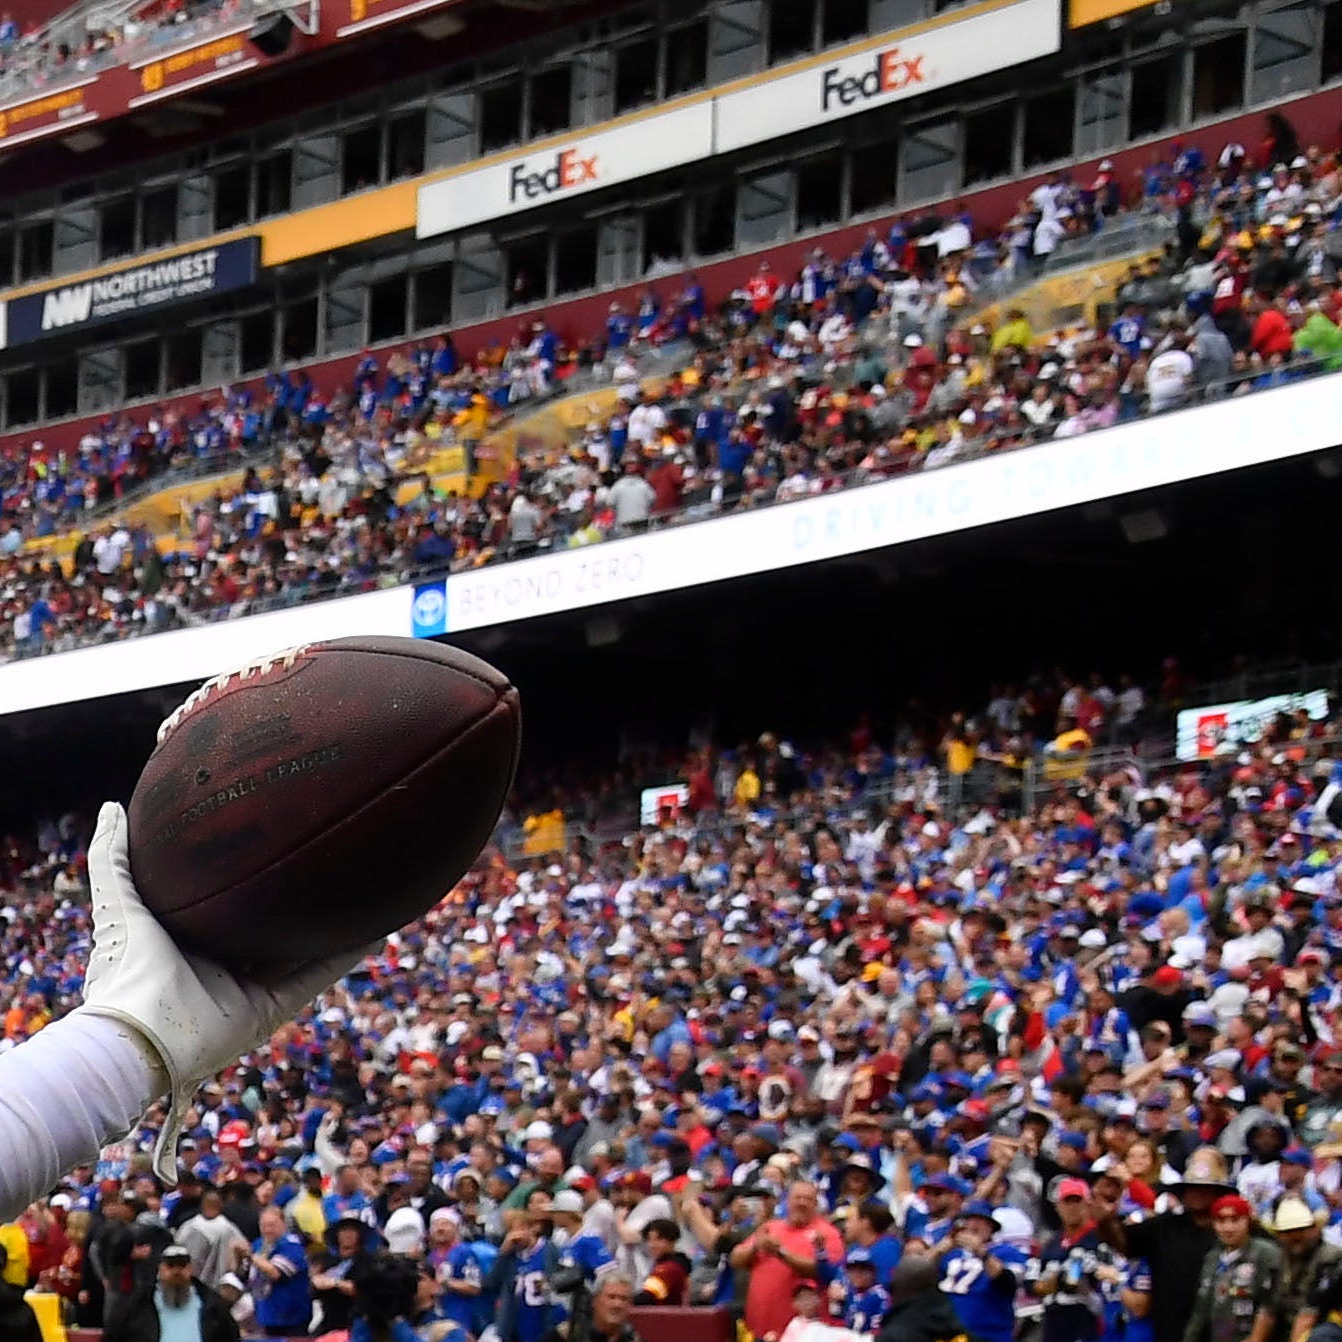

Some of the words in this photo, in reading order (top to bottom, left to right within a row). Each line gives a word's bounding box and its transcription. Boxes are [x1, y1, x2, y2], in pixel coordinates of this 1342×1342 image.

[822, 49, 924, 110] FedEx
[509, 149, 598, 204] FedEx
[93, 251, 219, 300] NORTHWEST
[458, 568, 563, 617] BEYOND
[574, 551, 646, 592] ZERO
[181, 777, 257, 825] FOOTBALL
[266, 742, 343, 785] LEAGUE
[938, 1257, 985, 1294] 17
